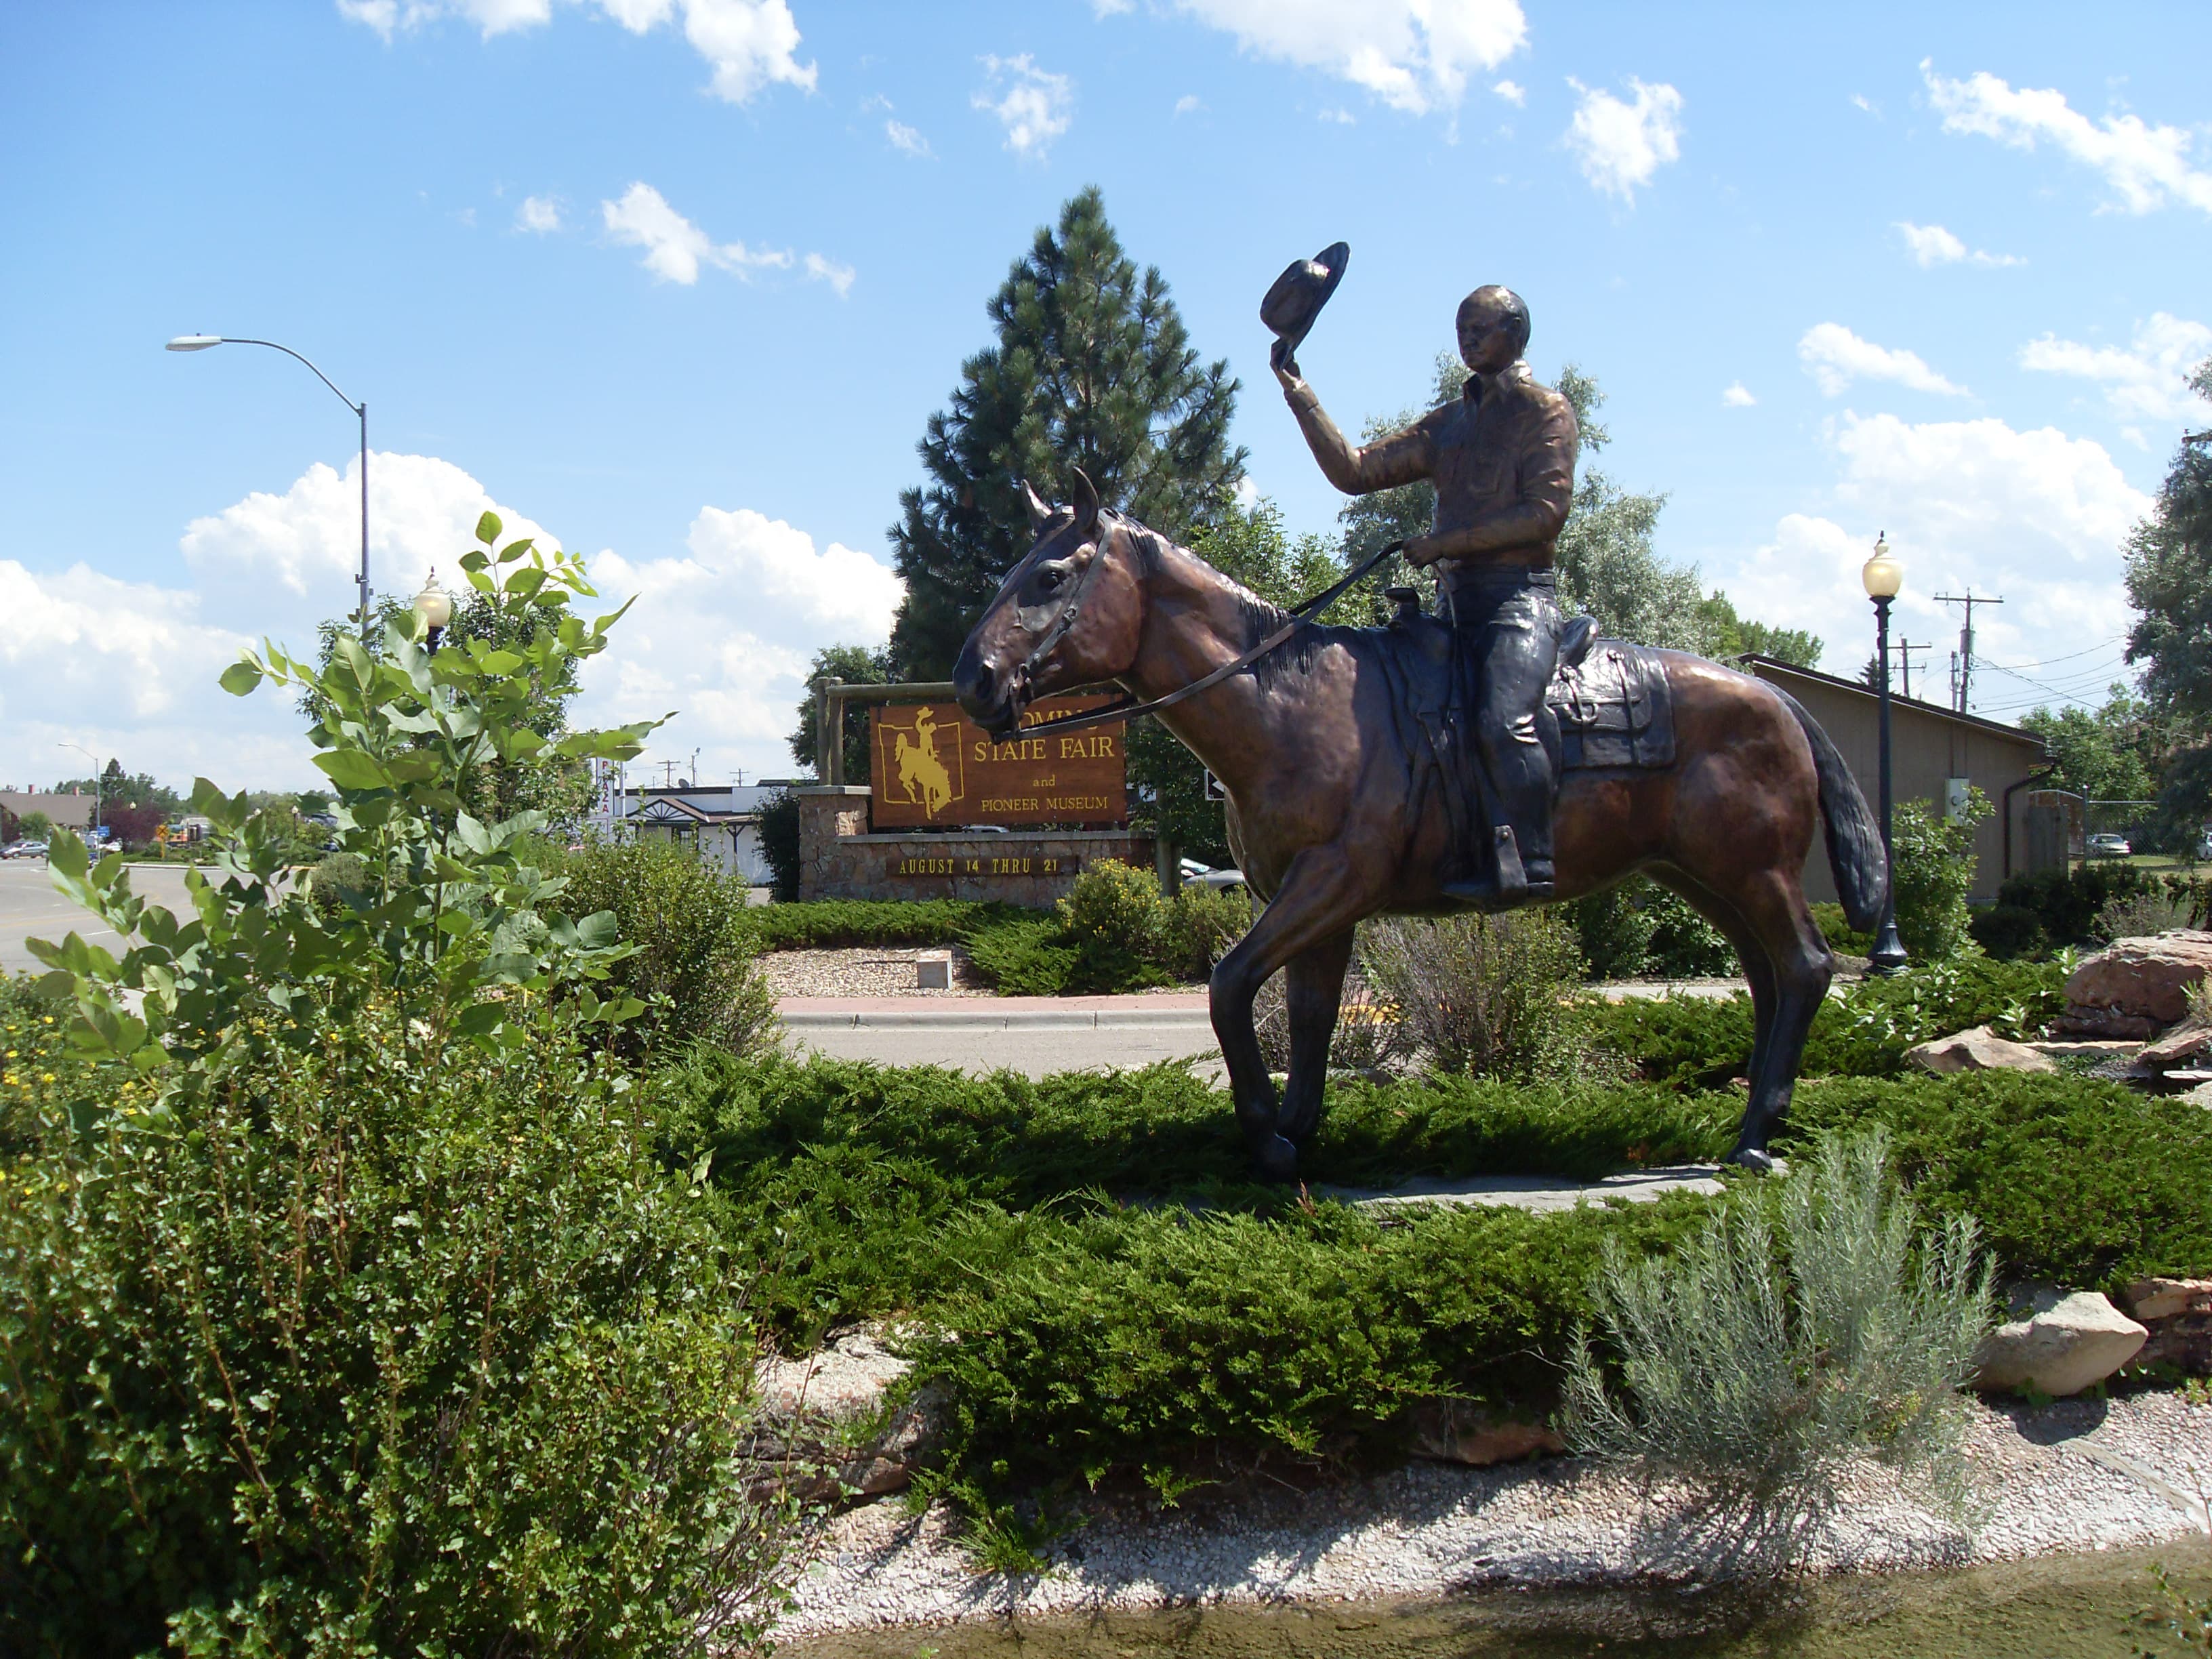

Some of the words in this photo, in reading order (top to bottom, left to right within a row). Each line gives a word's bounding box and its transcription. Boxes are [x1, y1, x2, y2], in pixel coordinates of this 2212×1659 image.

[975, 739, 1046, 762] STATE
[1060, 737, 1115, 758] FAIR
[1033, 774, 1056, 787] and
[981, 798, 1040, 812] PIONEER
[1046, 796, 1108, 810] MUSEUM
[899, 859, 954, 874] AUGUST
[966, 859, 979, 872] 14
[992, 858, 1030, 874] THRU
[1044, 859, 1057, 872] 21
